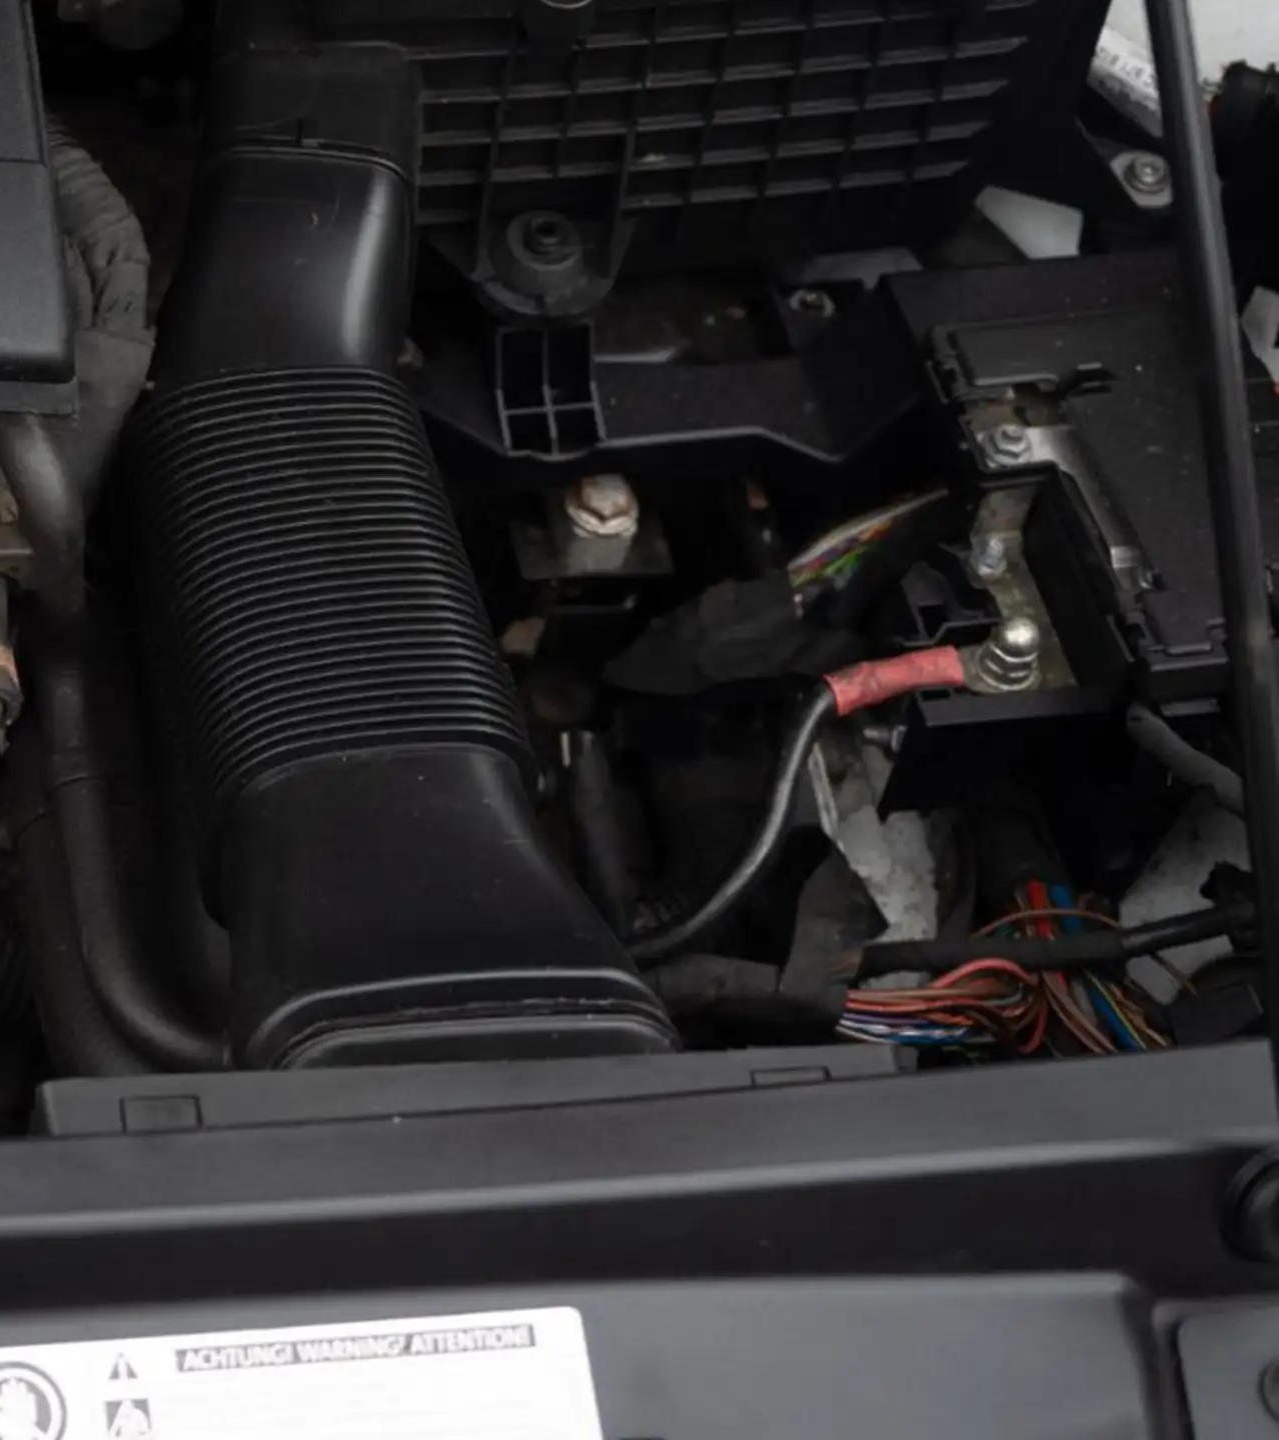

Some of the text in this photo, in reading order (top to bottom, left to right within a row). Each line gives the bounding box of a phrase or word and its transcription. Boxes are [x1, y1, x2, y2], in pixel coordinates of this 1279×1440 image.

[183, 1324, 532, 1371] ACHTUNG! WARNING! ATTENTION!
